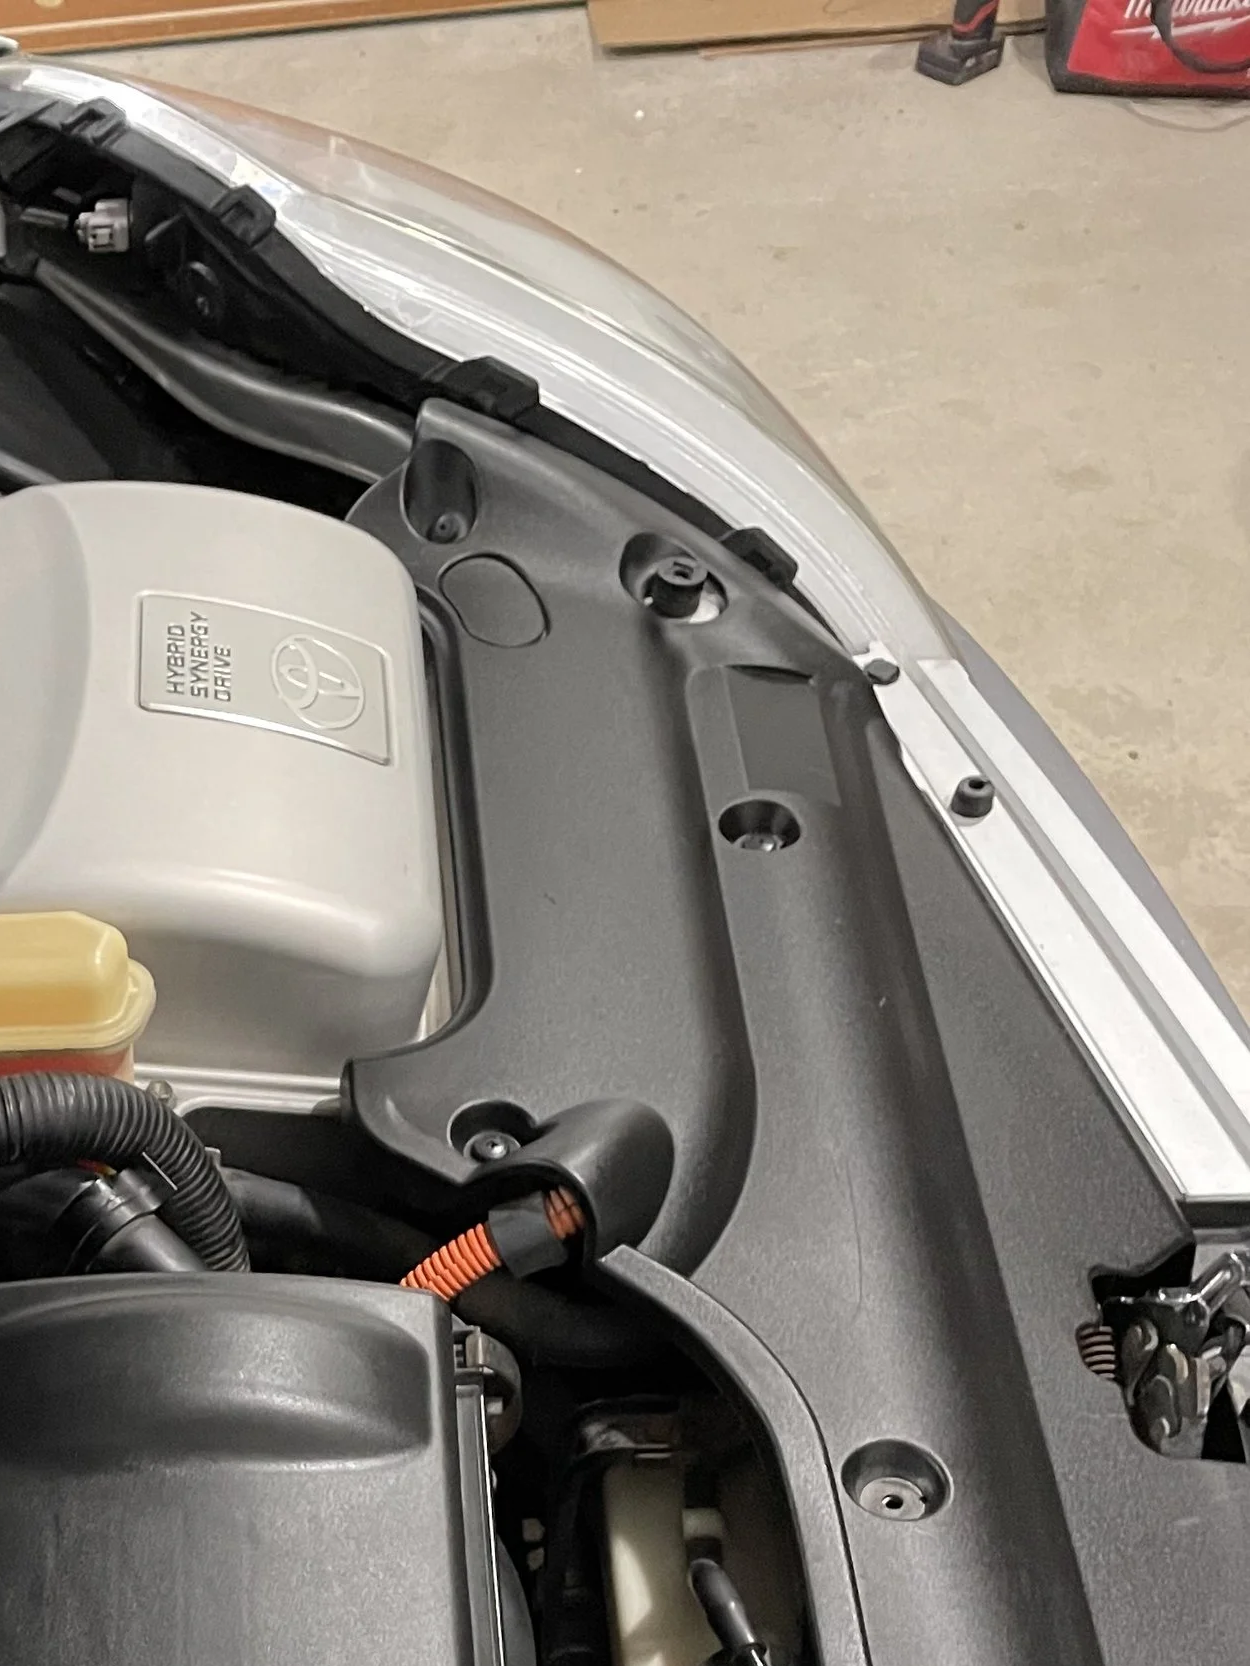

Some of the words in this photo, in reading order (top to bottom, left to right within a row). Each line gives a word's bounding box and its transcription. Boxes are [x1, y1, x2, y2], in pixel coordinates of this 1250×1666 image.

[166, 624, 185, 695] HYBRID
[189, 610, 209, 699] SYNERGY
[213, 645, 233, 702] DRIVE
